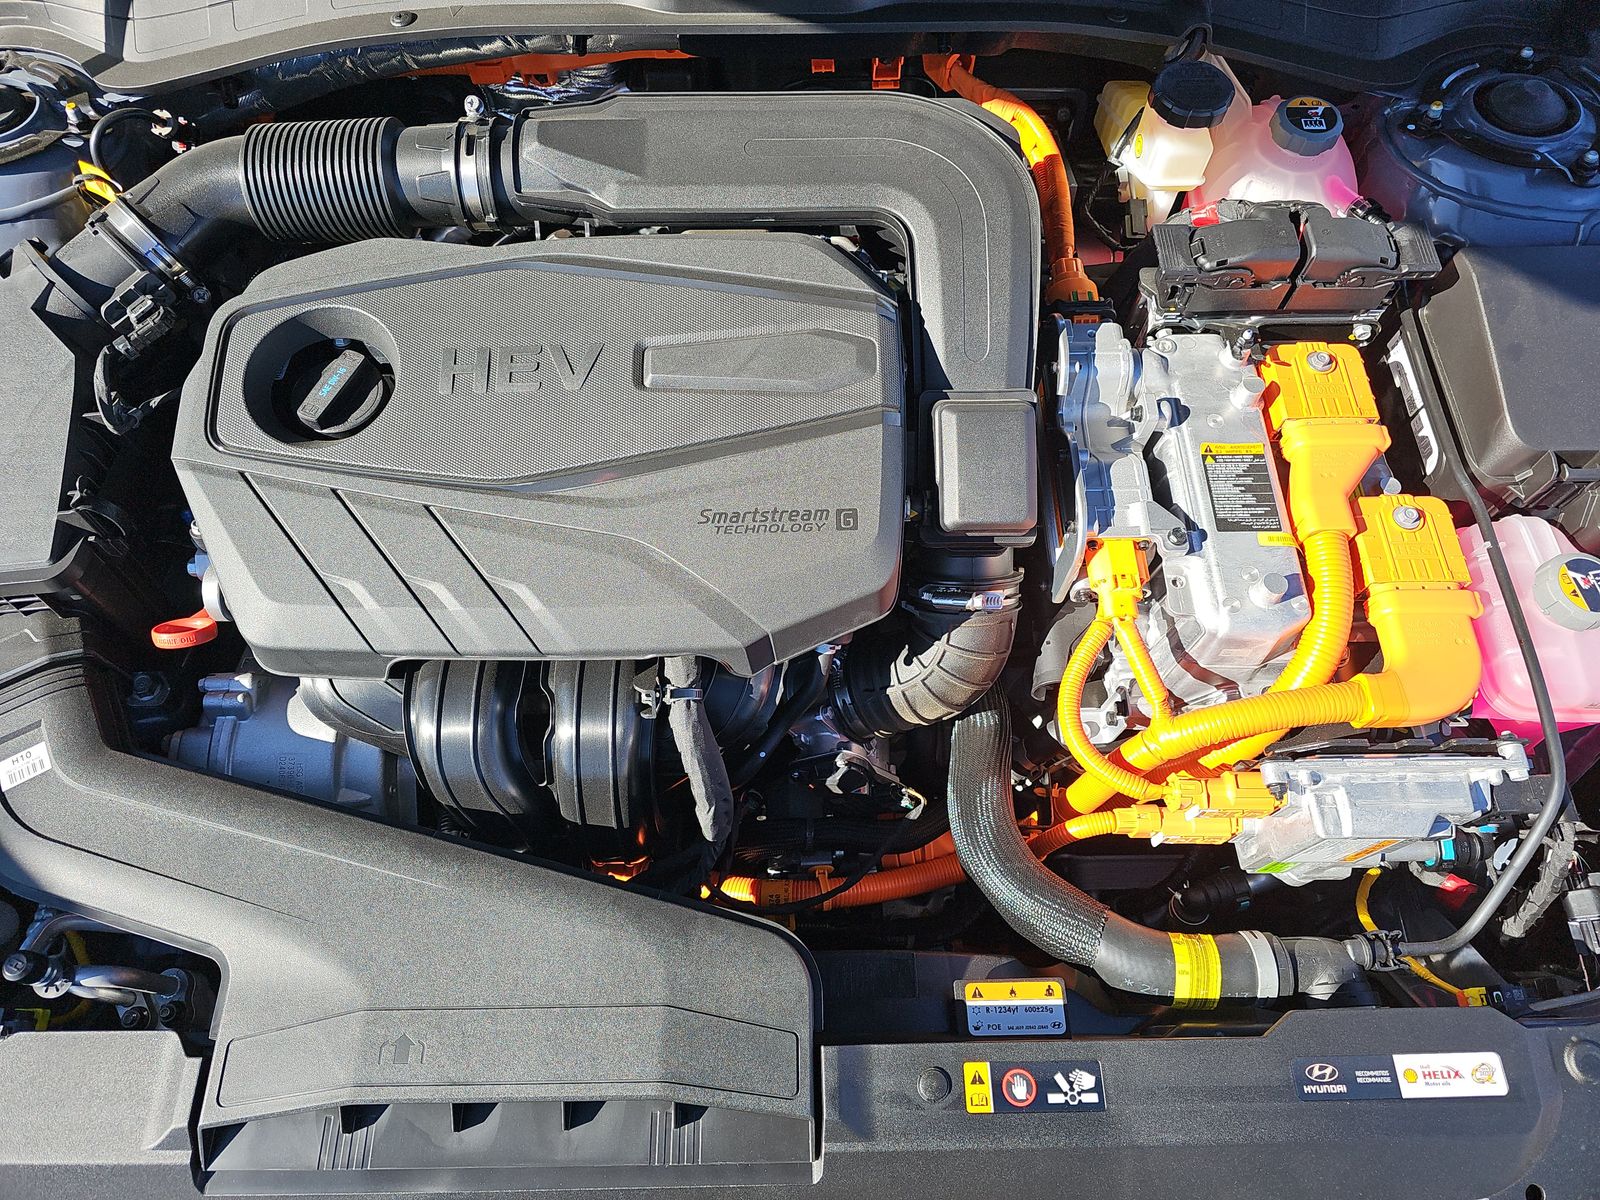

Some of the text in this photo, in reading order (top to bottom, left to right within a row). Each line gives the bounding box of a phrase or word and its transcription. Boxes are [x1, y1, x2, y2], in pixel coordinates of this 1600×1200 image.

[438, 343, 606, 395] HEV
[318, 383, 332, 397] SAE
[697, 507, 857, 529] Smartstream G
[713, 522, 826, 535] TECHNOLOGY
[11, 750, 32, 766] H10
[985, 1005, 1054, 1015] R-1234yf 600±25g
[987, 1023, 1002, 1031] POE
[1421, 1070, 1463, 1080] HELIX
[1303, 1084, 1348, 1094] HYUNDAI
